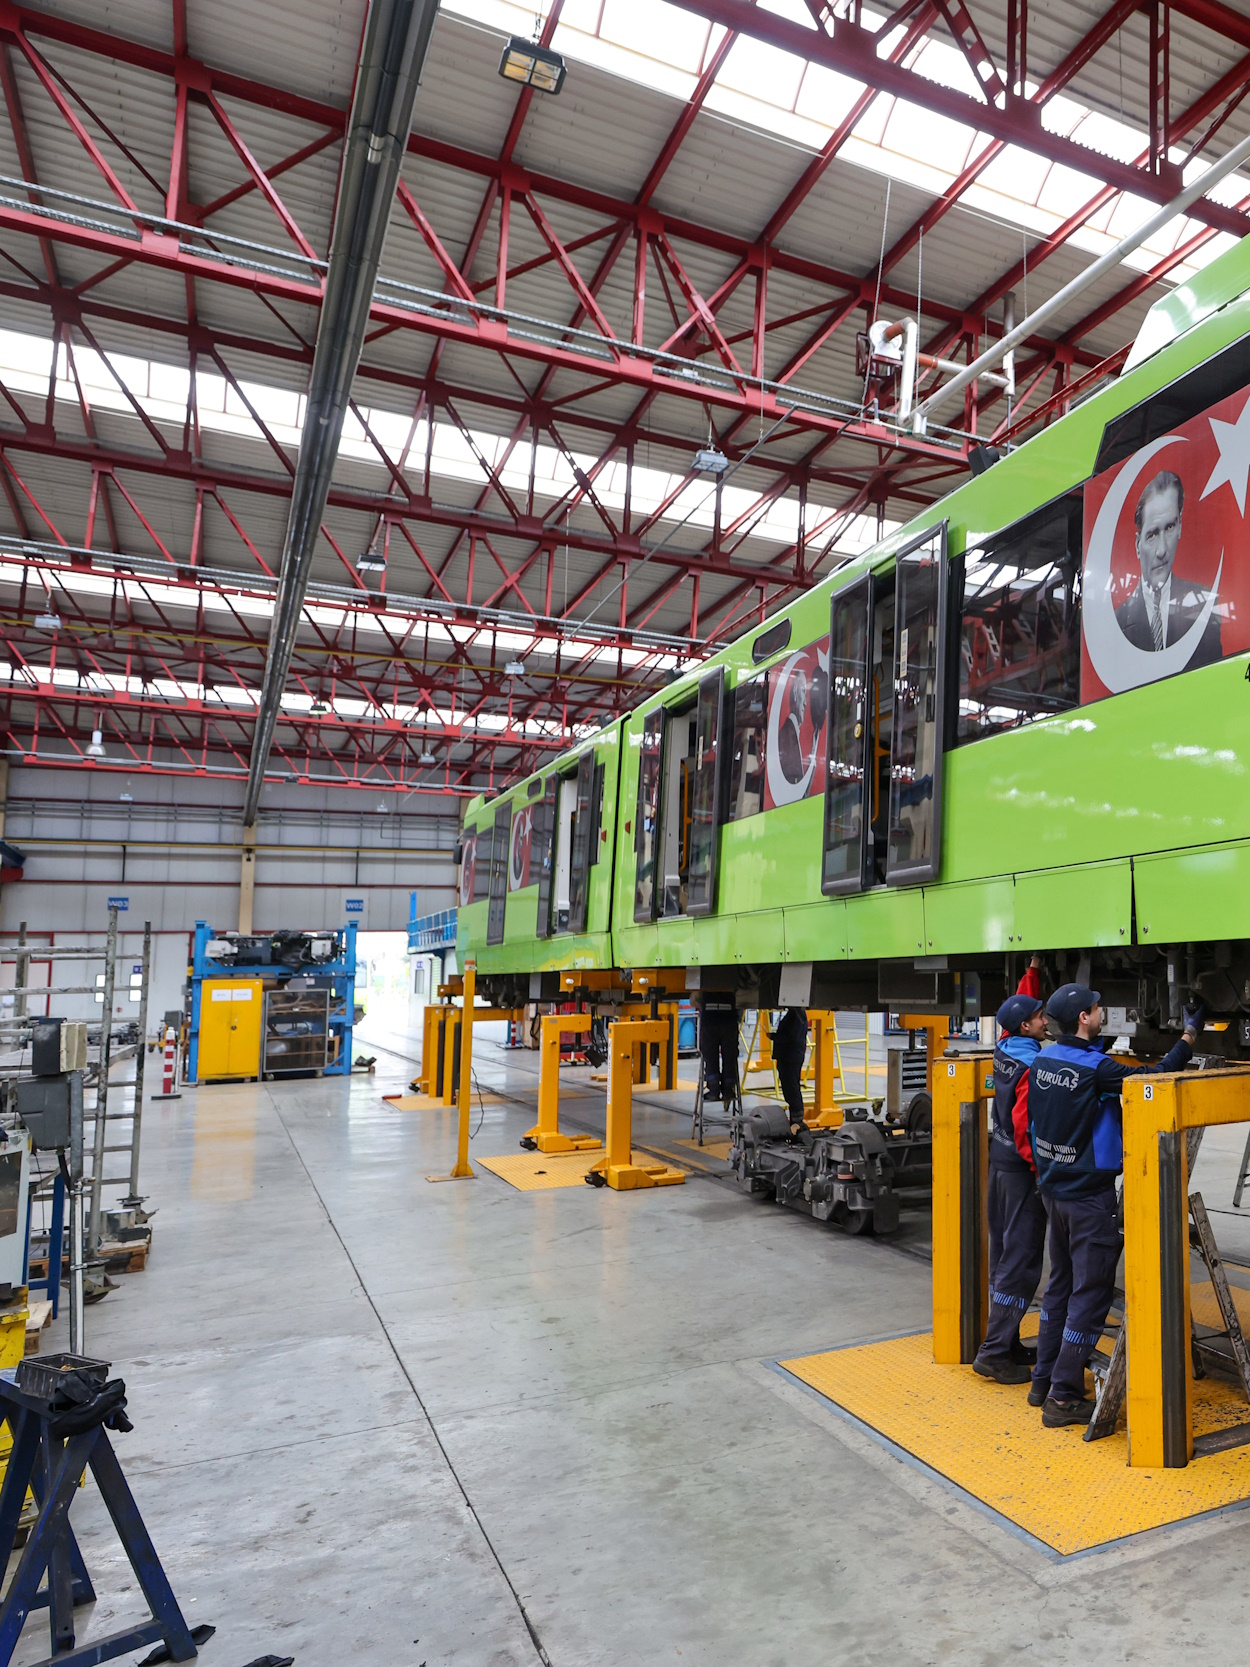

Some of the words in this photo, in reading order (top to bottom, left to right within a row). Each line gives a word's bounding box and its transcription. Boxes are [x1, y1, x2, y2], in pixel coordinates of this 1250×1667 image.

[949, 1064, 955, 1076] 3
[1036, 1068, 1080, 1091] BURULAŞ
[1145, 1086, 1152, 1099] 3
